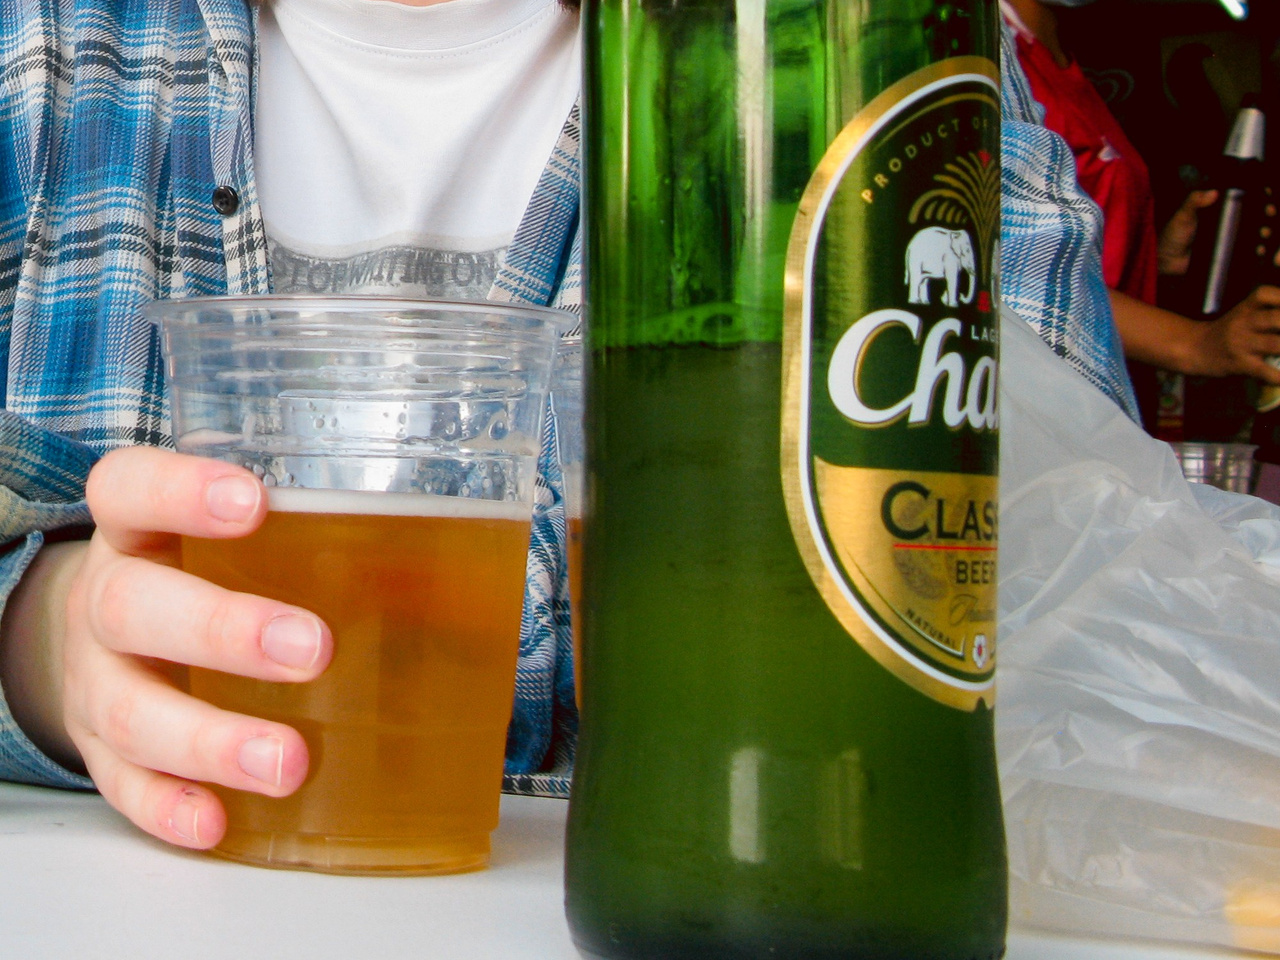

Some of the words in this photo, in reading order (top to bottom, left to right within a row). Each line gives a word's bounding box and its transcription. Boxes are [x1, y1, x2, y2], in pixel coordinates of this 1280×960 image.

[860, 119, 960, 204] PRODUCT
[827, 308, 999, 429] Cha
[881, 481, 999, 541] CLAS
[905, 608, 957, 649] NATURAL
